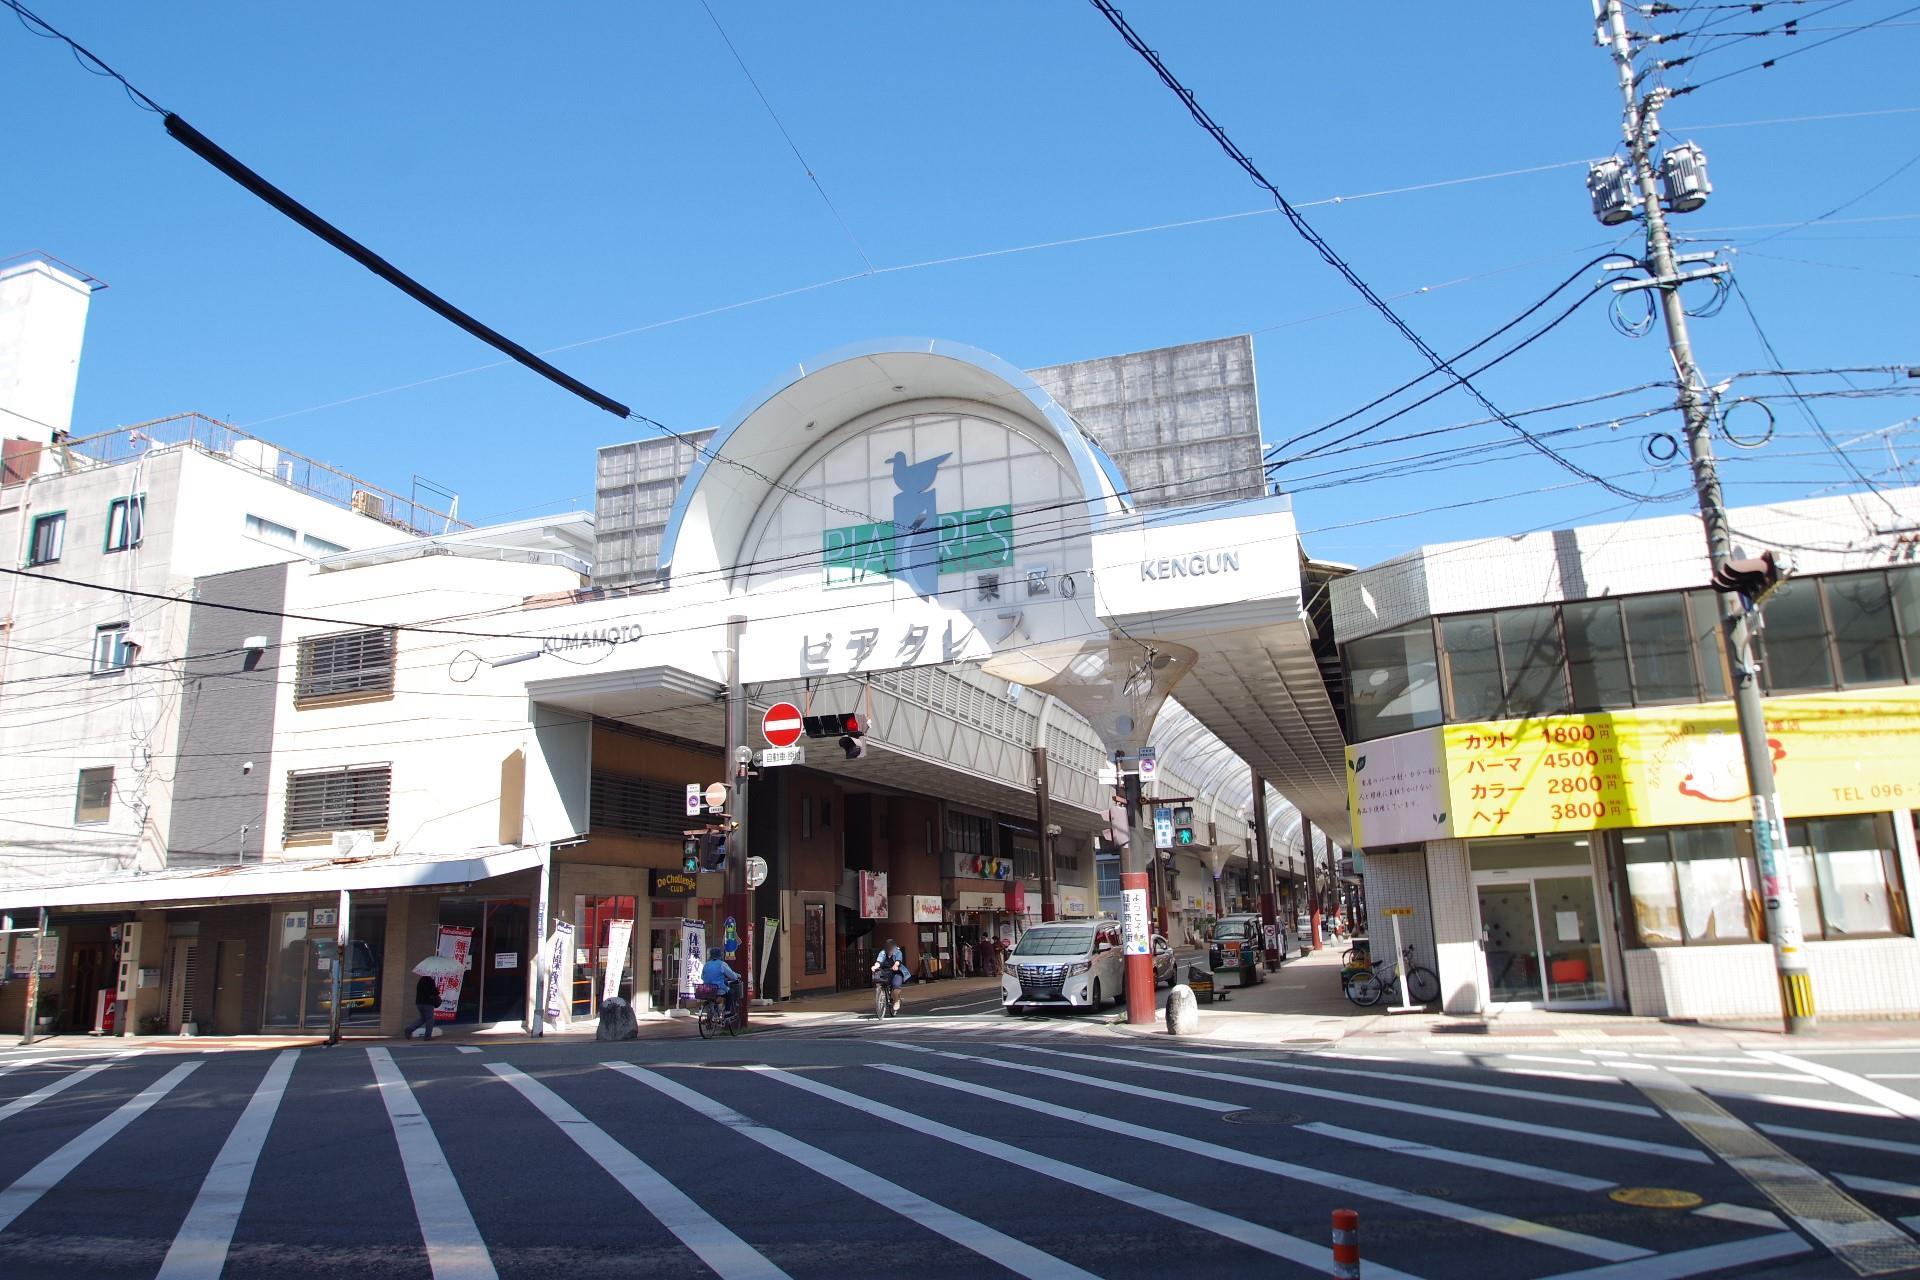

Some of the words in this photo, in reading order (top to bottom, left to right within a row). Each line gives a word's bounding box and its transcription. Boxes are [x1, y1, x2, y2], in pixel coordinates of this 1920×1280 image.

[1140, 551, 1239, 582] KENGUN
[543, 624, 643, 653] KUMAMOTO
[1465, 732, 1513, 750] カット
[1471, 783, 1525, 800] カラー
[1832, 787, 1864, 802] TEL
[1473, 807, 1511, 824] ヘナ
